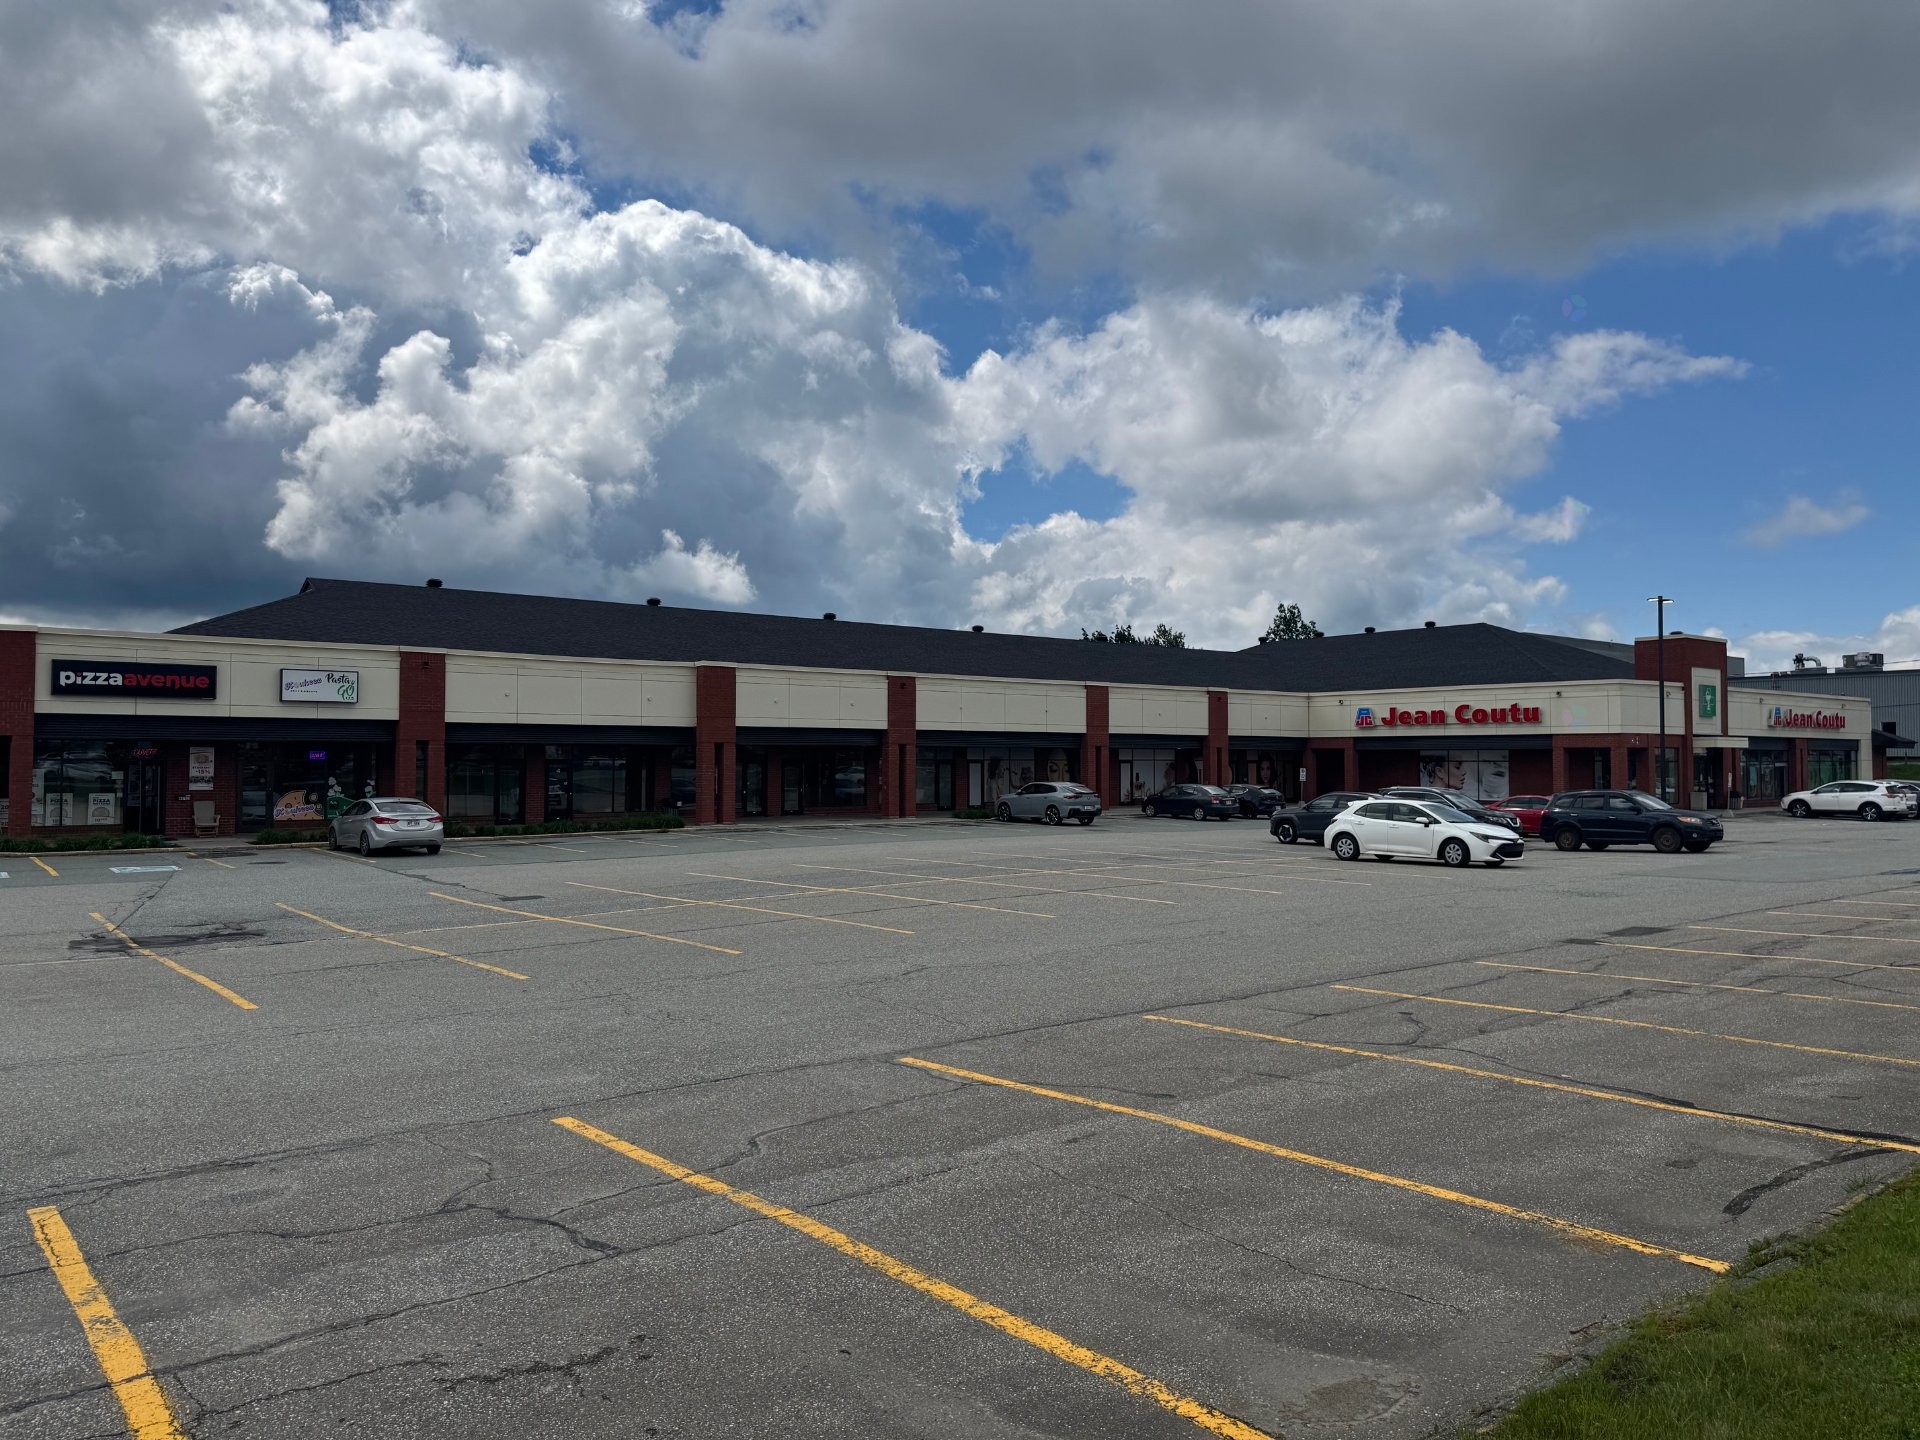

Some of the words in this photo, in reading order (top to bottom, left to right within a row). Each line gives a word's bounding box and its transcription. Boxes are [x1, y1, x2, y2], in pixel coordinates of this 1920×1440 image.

[325, 672, 350, 685] Pasta
[1381, 707, 1446, 727] Jean
[1455, 703, 1541, 725] Coutu
[1785, 708, 1813, 728] Jean
[1815, 709, 1846, 729] Coutu
